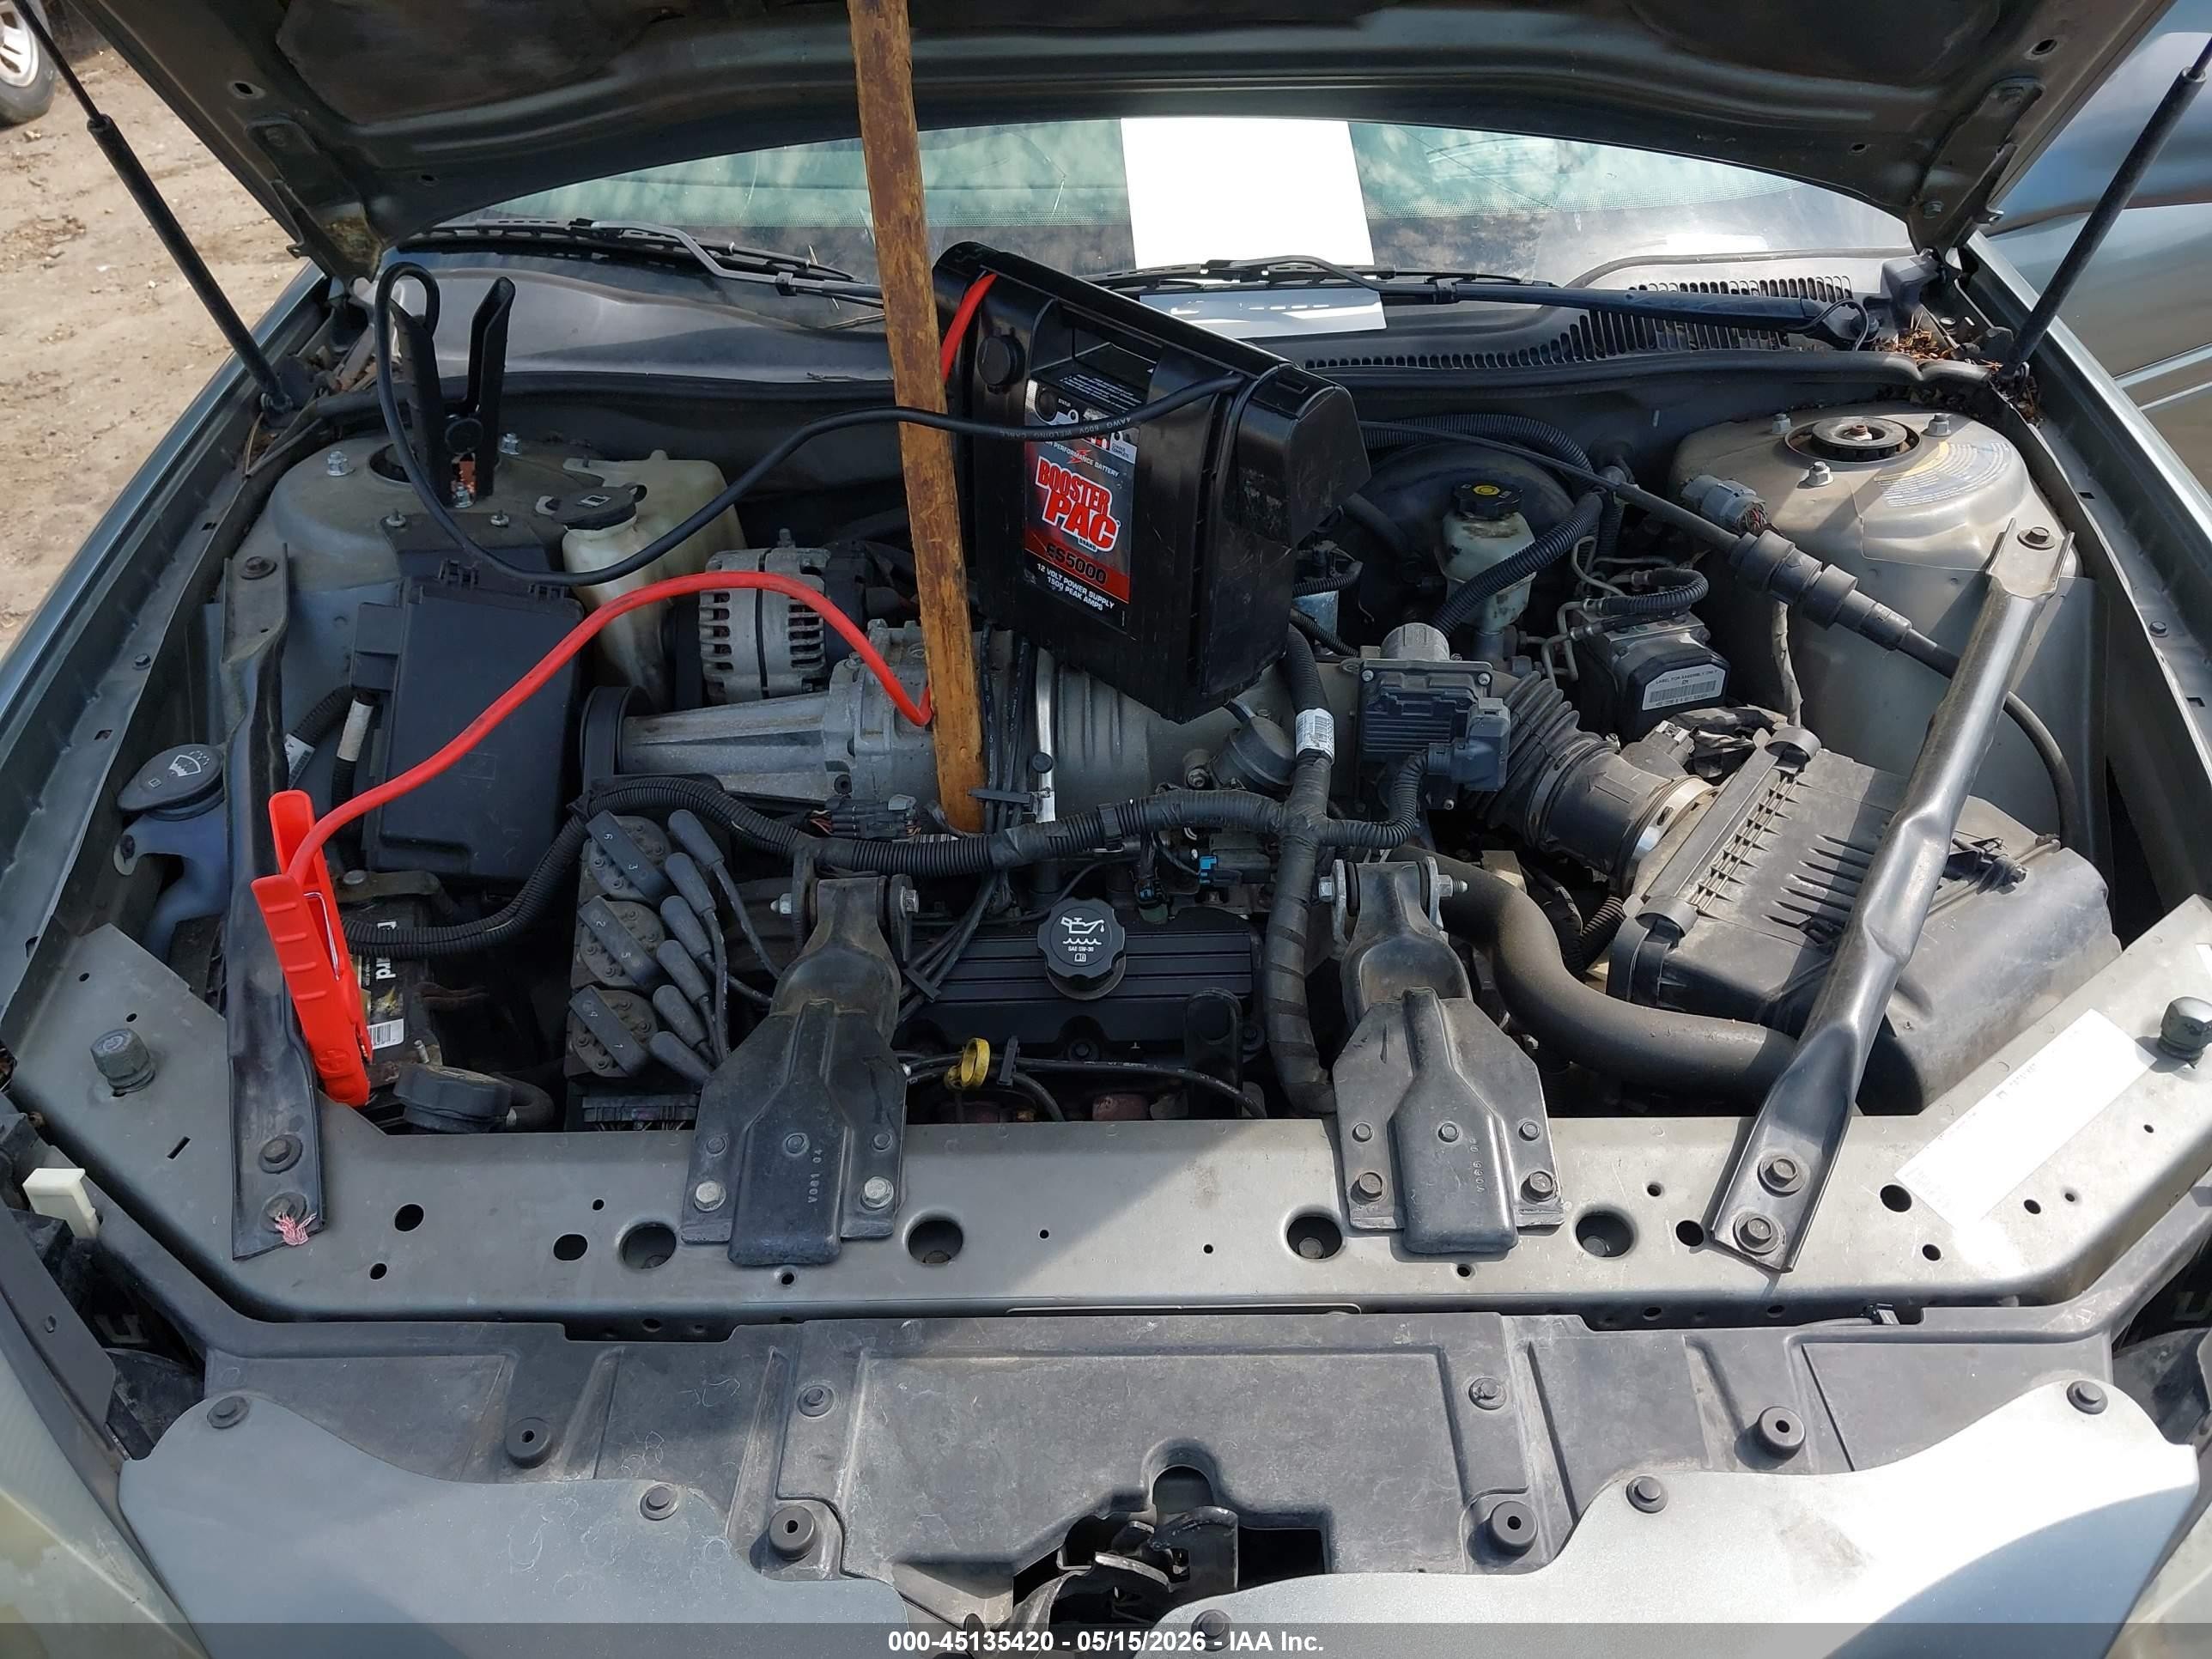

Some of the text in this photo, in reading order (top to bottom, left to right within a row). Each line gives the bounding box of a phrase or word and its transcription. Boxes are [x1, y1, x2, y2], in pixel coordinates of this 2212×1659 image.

[1034, 429, 1073, 438] WELDING
[1106, 416, 1131, 428] 4AWG
[1054, 441, 1093, 465] PERFORMANCE
[1095, 462, 1120, 477] BATTERY
[1036, 457, 1111, 516] BOOSTER
[1043, 489, 1117, 550] PAC
[1047, 543, 1107, 585] ES5000
[1036, 563, 1046, 573] 12
[1047, 567, 1062, 580] VOLT
[1064, 577, 1087, 593] POWER
[1088, 591, 1115, 609] SUPPLY
[1047, 577, 1103, 611] 1500 PEAK AMPS
